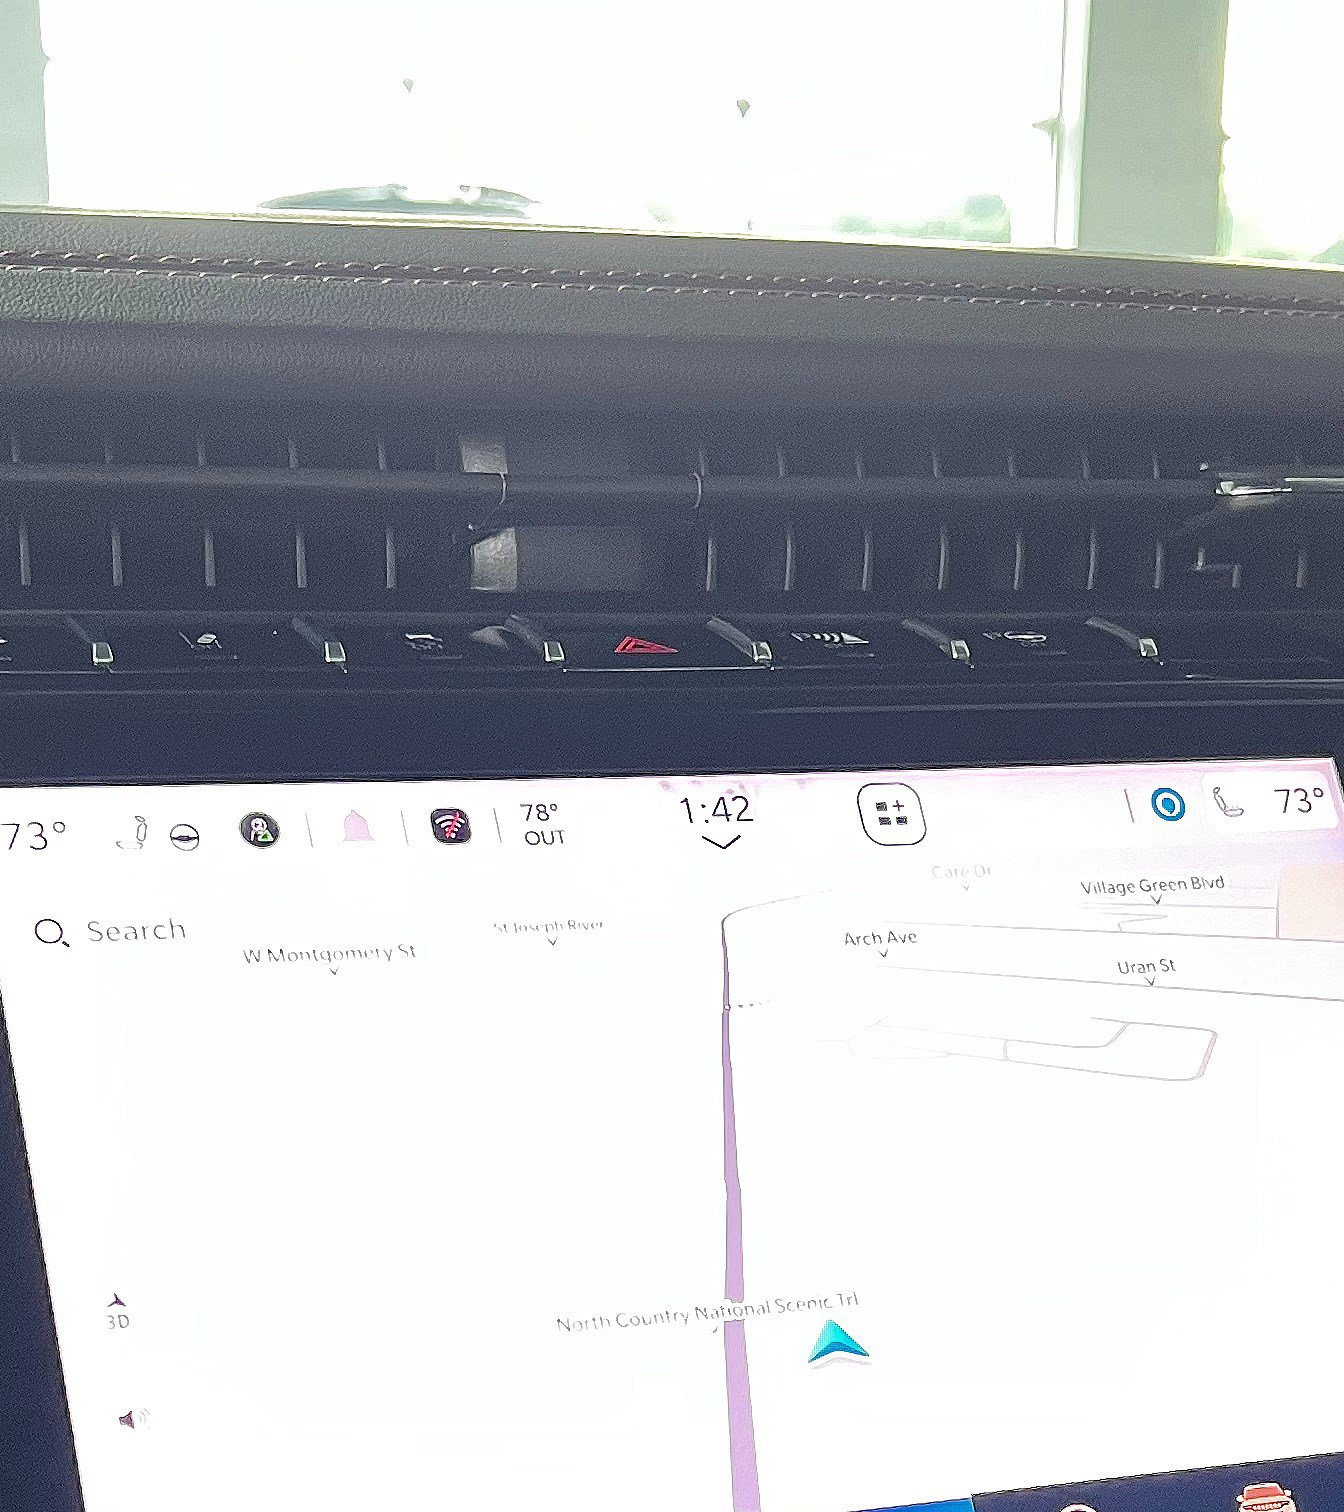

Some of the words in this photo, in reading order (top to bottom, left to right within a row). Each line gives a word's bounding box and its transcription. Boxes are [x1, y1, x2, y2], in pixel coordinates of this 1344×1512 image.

[679, 794, 754, 824] 1:42
[1273, 786, 1325, 814] 73°
[519, 802, 558, 822] 78°
[0, 820, 66, 851] 73°
[524, 828, 566, 847] OUT
[1080, 880, 1136, 897] Village
[1139, 877, 1188, 893] Green
[1190, 874, 1226, 891] Blvd
[86, 917, 187, 942] Search
[844, 931, 883, 946] Arch
[886, 929, 917, 944] Ave
[242, 949, 262, 964] W
[1116, 960, 1157, 975] Uran
[1158, 957, 1177, 973] St
[556, 1316, 612, 1333] North
[615, 1308, 691, 1330] Country
[693, 1300, 772, 1322] National
[774, 1295, 835, 1315] Scenic
